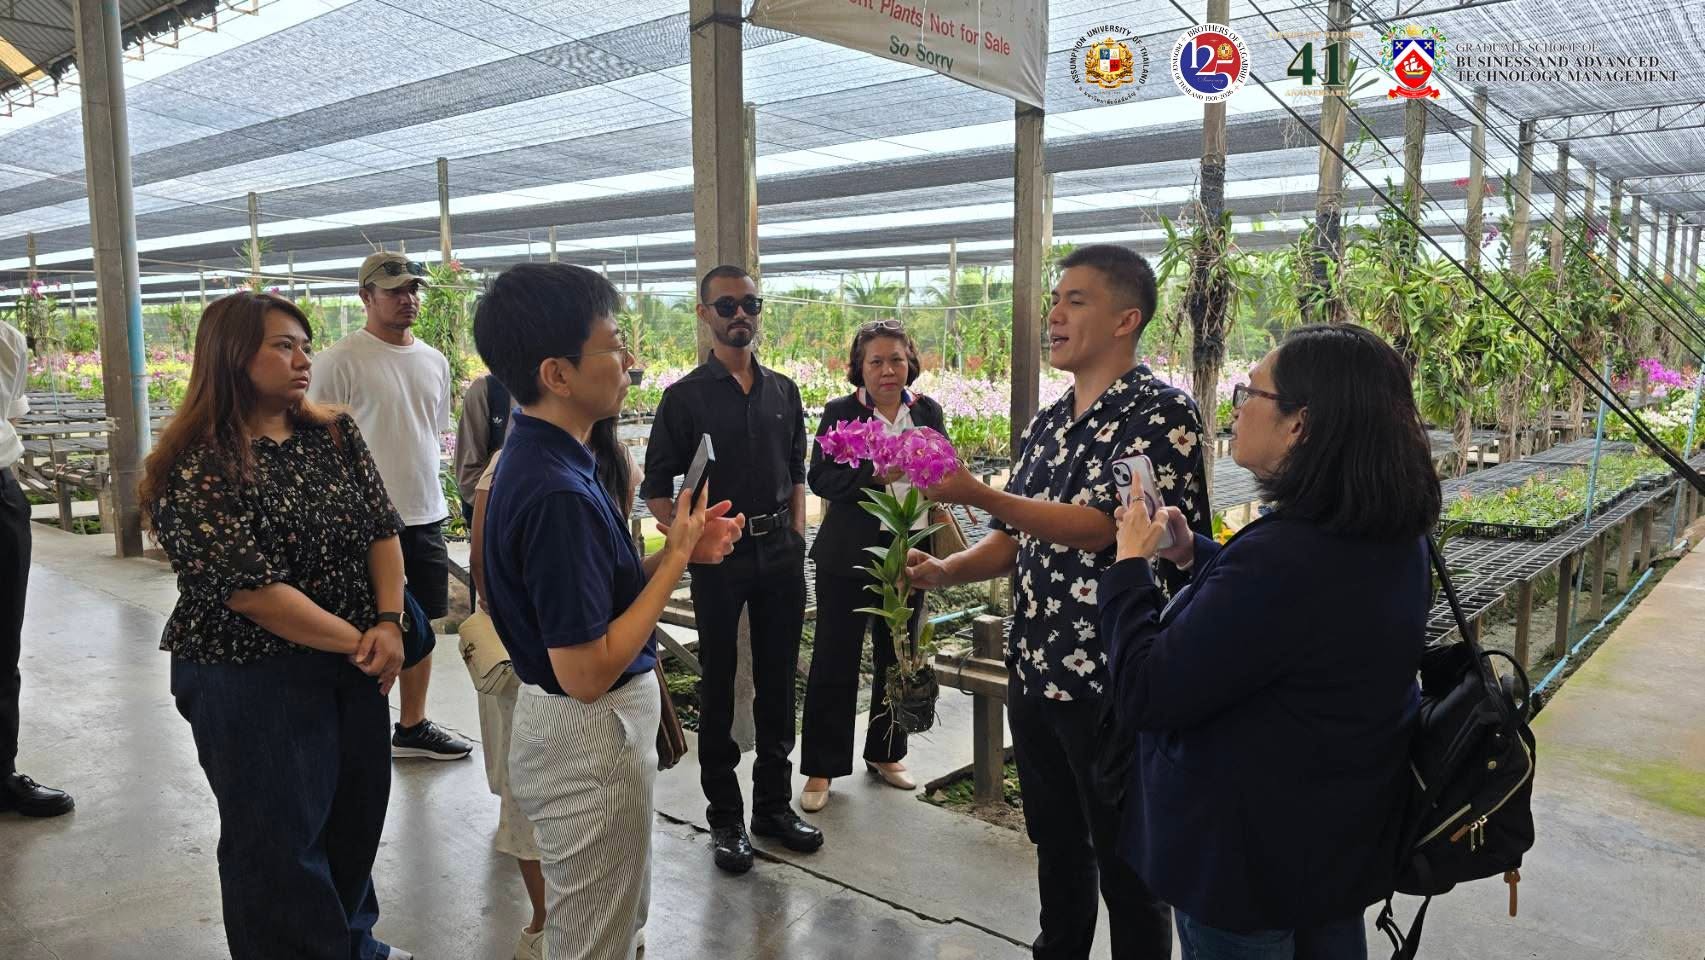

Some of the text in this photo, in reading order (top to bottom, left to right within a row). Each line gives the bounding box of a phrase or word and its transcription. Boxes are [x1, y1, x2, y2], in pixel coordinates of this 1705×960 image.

[880, 0, 923, 28] Plants
[930, 12, 954, 38] Not
[960, 24, 979, 45] for
[984, 31, 1010, 56] Sale
[889, 35, 954, 72] So Sorry
